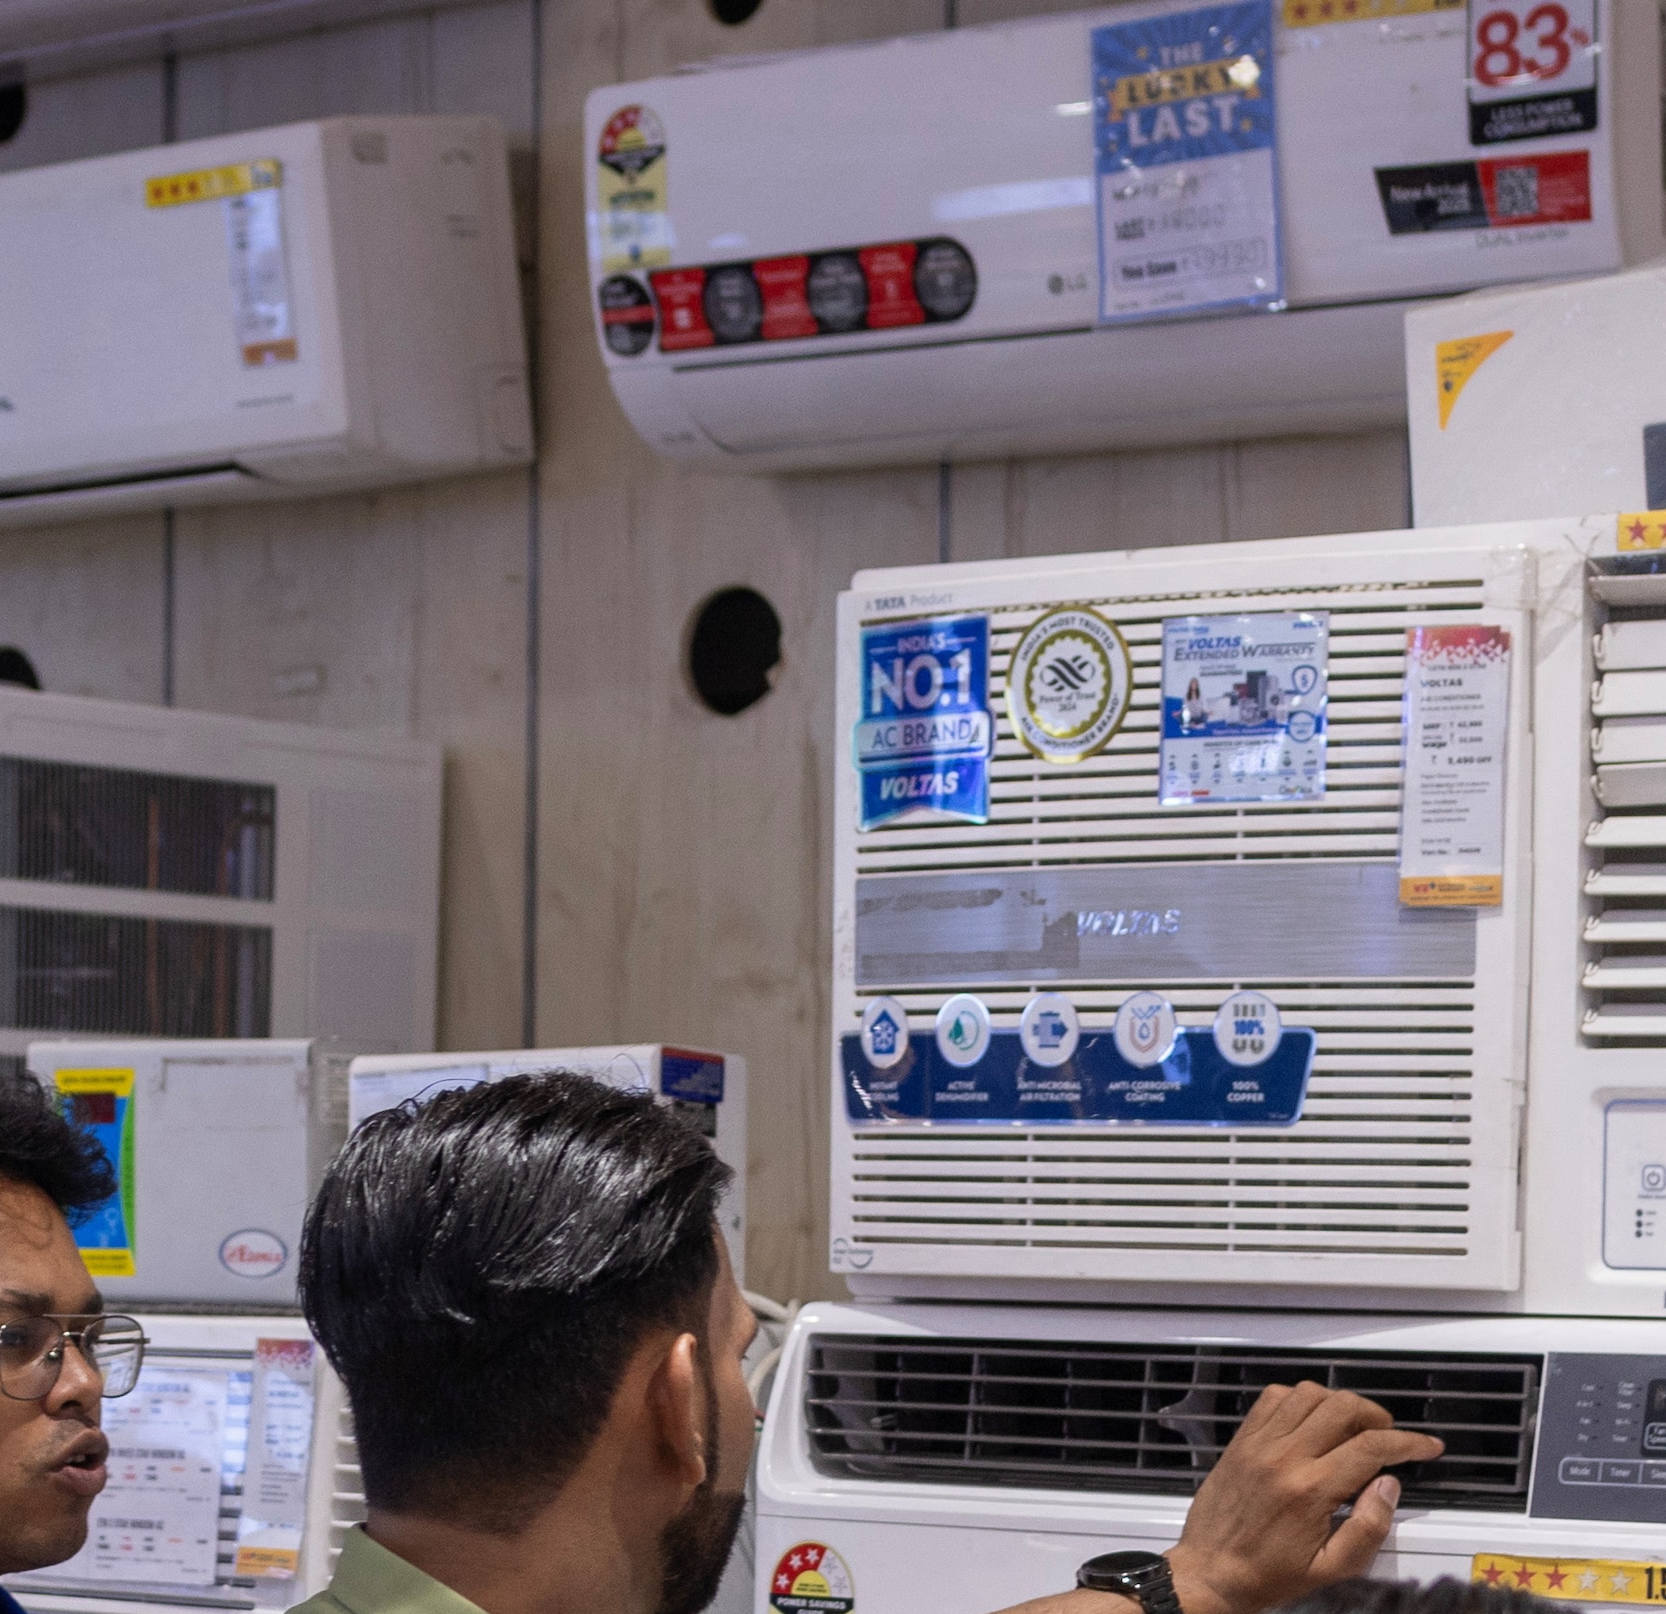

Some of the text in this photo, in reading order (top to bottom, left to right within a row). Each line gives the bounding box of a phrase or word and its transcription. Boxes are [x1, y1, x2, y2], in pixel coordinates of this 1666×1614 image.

[1160, 41, 1204, 66] THE
[1128, 95, 1239, 148] LAST
[875, 596, 905, 611] TATA
[1049, 616, 1076, 630] MOST
[1079, 617, 1116, 650] TRUSTED
[1188, 636, 1241, 649] VOLTAS
[870, 648, 973, 715] NO.1
[1420, 678, 1463, 688] VOLTAS
[872, 717, 973, 749] AC BRAND
[880, 770, 960, 800] VOLTAS
[1076, 909, 1181, 936] VOLTAS
[1226, 1091, 1265, 1103] COPPER
[1569, 1466, 1592, 1476] Mode
[1610, 1467, 1632, 1478] Timer
